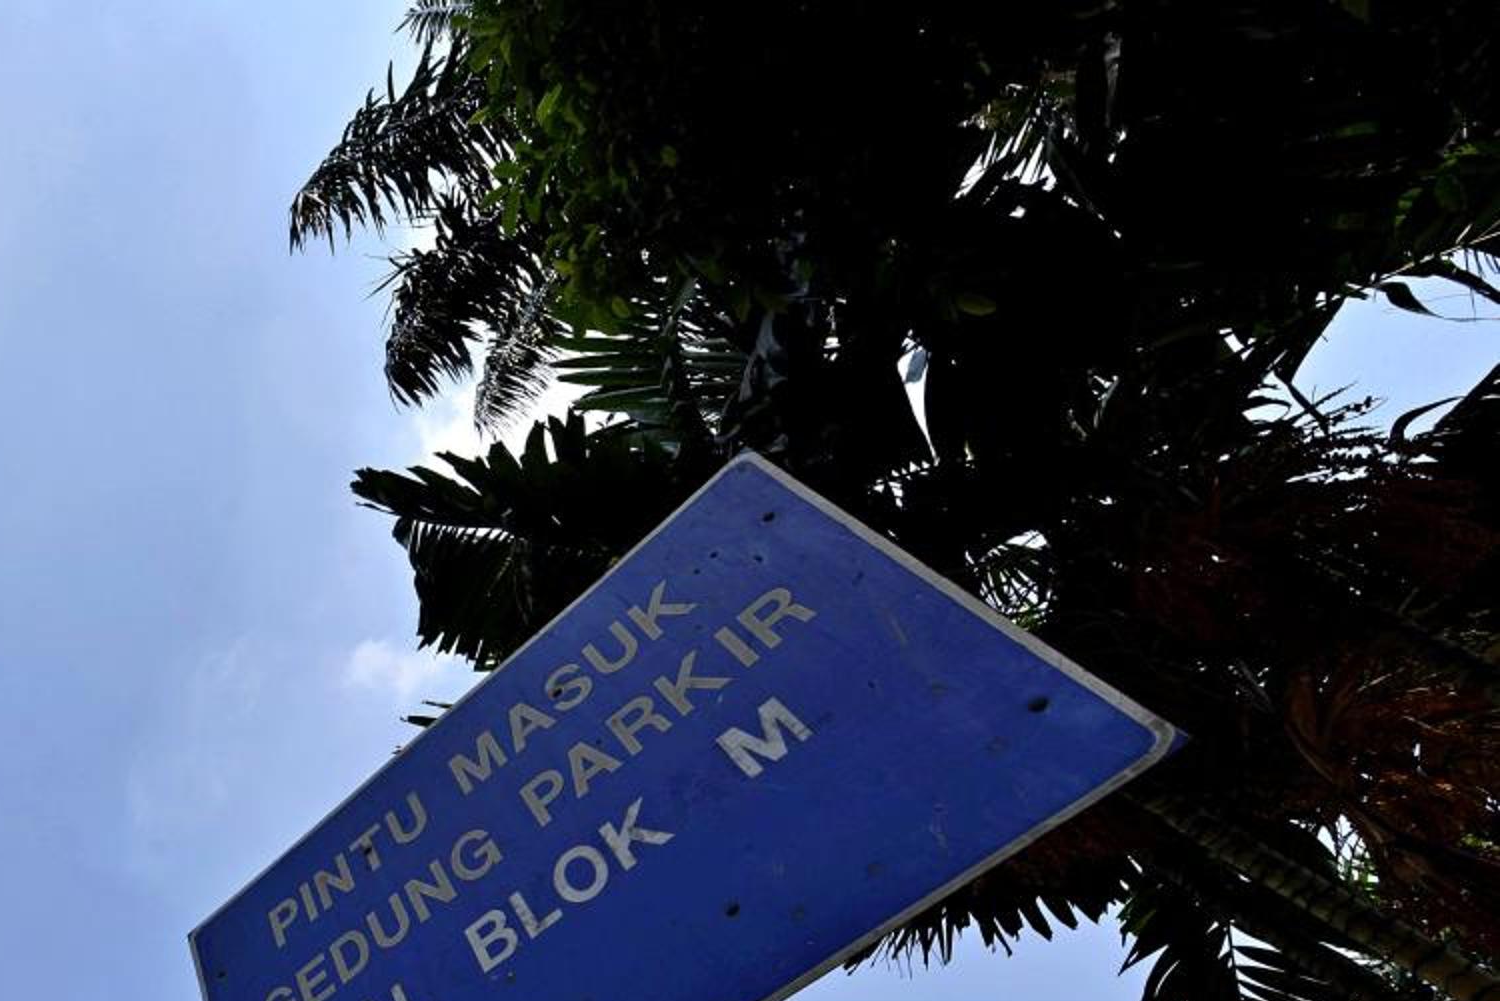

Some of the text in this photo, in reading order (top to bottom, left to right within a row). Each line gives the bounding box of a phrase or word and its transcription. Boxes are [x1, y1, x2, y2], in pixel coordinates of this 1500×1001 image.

[267, 580, 697, 946] PINTU MASUK
[463, 796, 675, 974] BLOK
[715, 695, 813, 778] M
[518, 585, 817, 827] PARKIR
